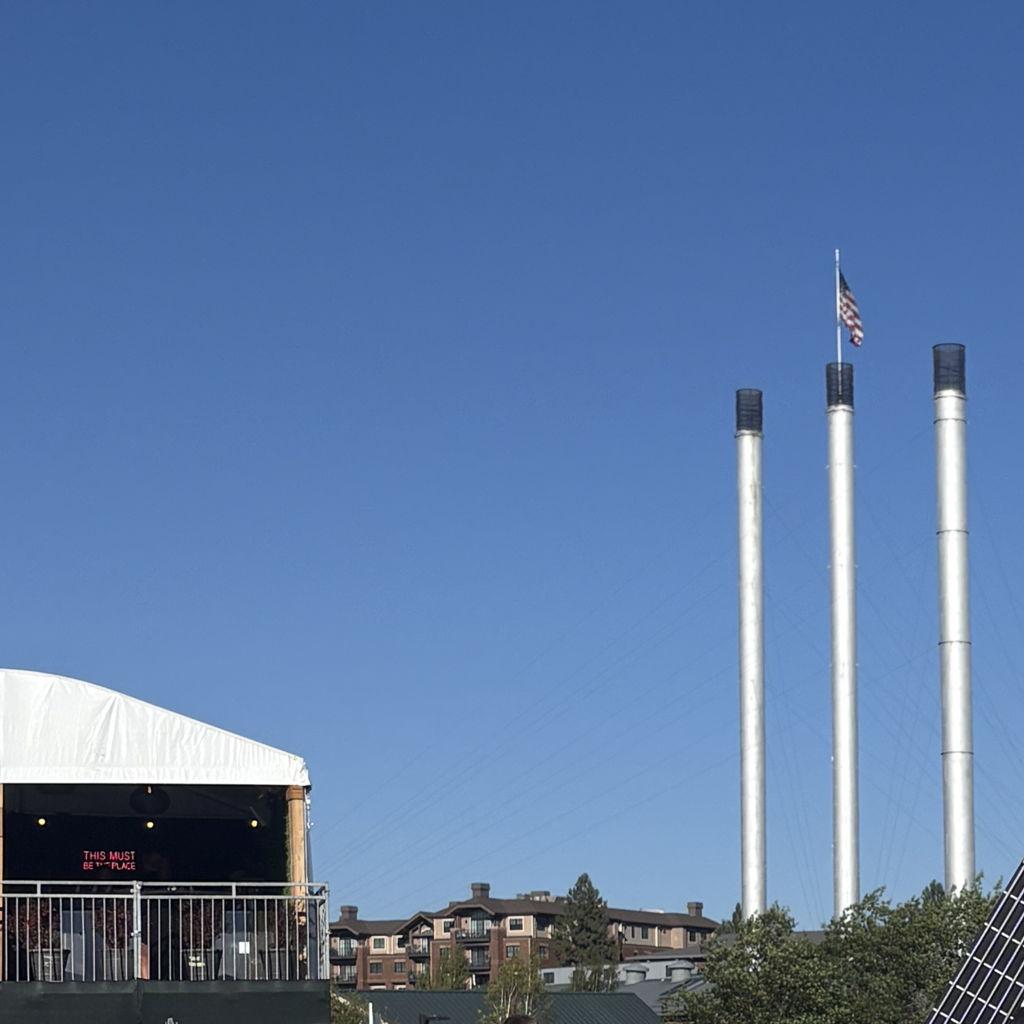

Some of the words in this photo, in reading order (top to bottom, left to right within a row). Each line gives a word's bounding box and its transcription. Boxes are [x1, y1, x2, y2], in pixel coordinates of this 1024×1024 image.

[83, 850, 106, 860] THIS
[109, 850, 136, 861] MUST
[83, 861, 94, 870] BE
[111, 861, 136, 870] PLACE
